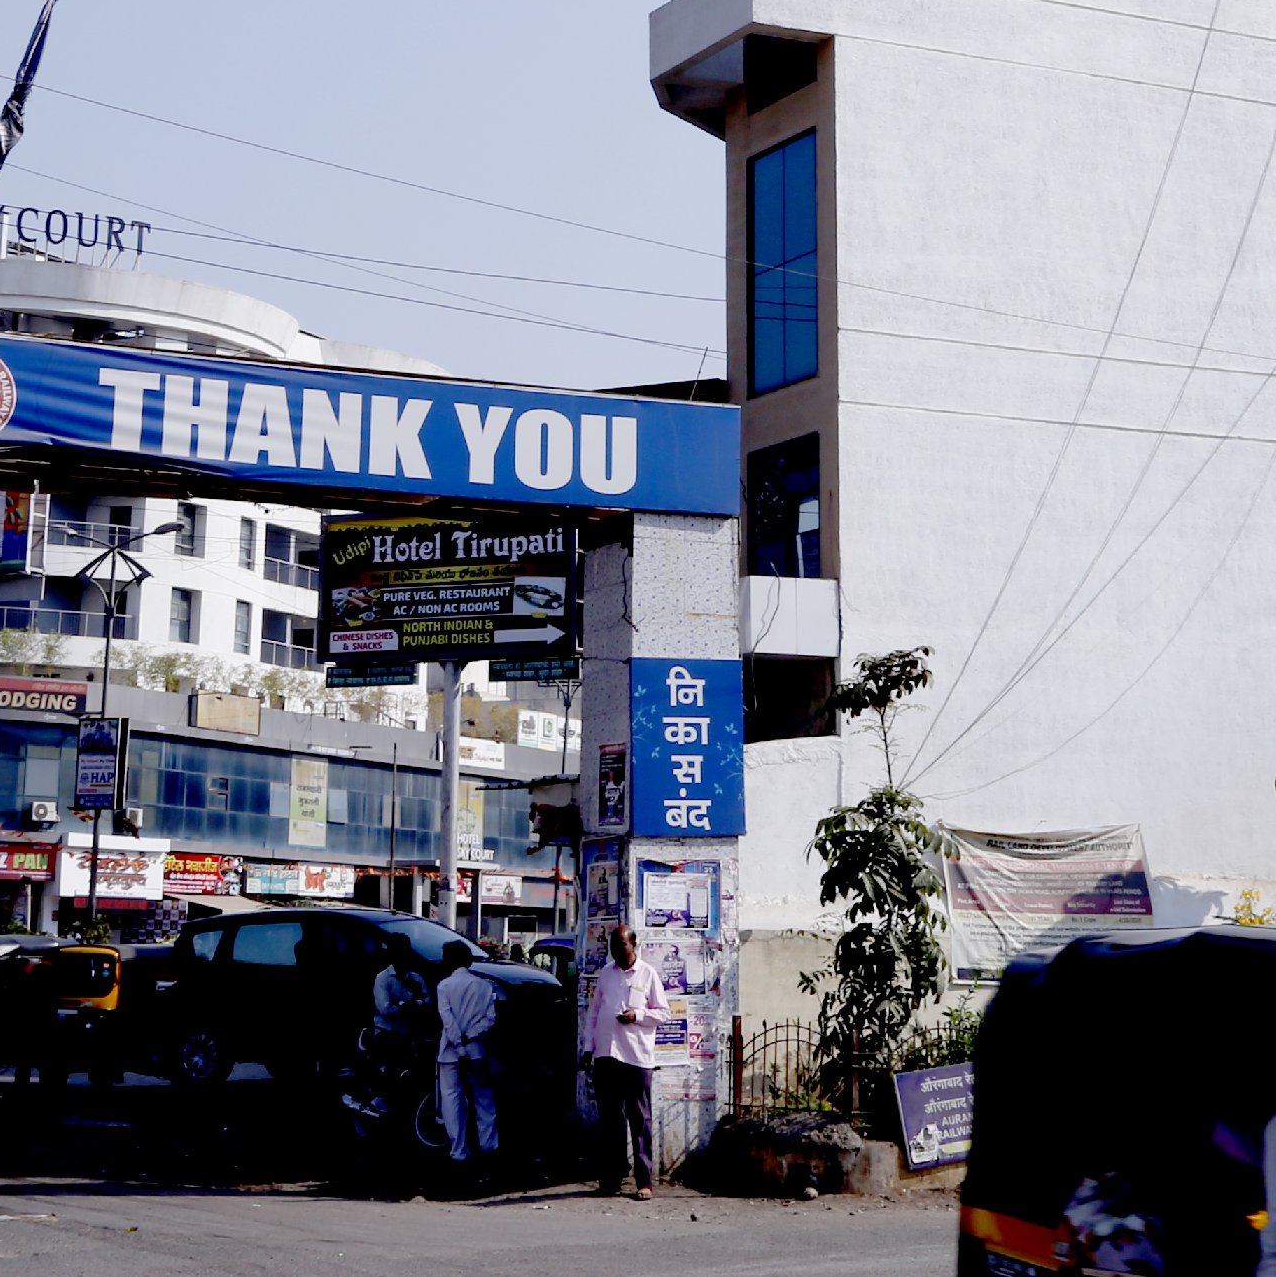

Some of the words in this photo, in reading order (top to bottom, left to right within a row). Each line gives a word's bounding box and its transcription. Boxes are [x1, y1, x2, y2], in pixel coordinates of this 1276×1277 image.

[16, 207, 151, 256] COURT
[99, 367, 434, 482] THANK
[458, 406, 638, 496] YOU
[331, 535, 372, 566] Udipi
[372, 531, 442, 564] Hotel
[451, 527, 565, 563] Tirupati
[383, 590, 412, 603] PURE
[413, 588, 435, 601] VEG.
[439, 586, 511, 600] RESTAURANT
[393, 604, 408, 616] AC
[418, 604, 442, 614] NON
[442, 603, 459, 613] AC
[460, 601, 500, 613] ROOMS
[403, 621, 441, 633] NORTH
[443, 620, 483, 632] INDIAN
[485, 620, 494, 630] &
[332, 632, 364, 642] CHINESE
[366, 630, 394, 641] DISHES
[402, 633, 449, 647] PUNJABI
[451, 632, 491, 645] DISHES
[351, 640, 383, 650] SNACKS
[663, 787, 712, 831] बंद
[456, 833, 480, 845] HOTEL
[12, 852, 49, 870] PAN
[470, 847, 495, 861] COURT
[935, 1124, 973, 1142] RAILWA
